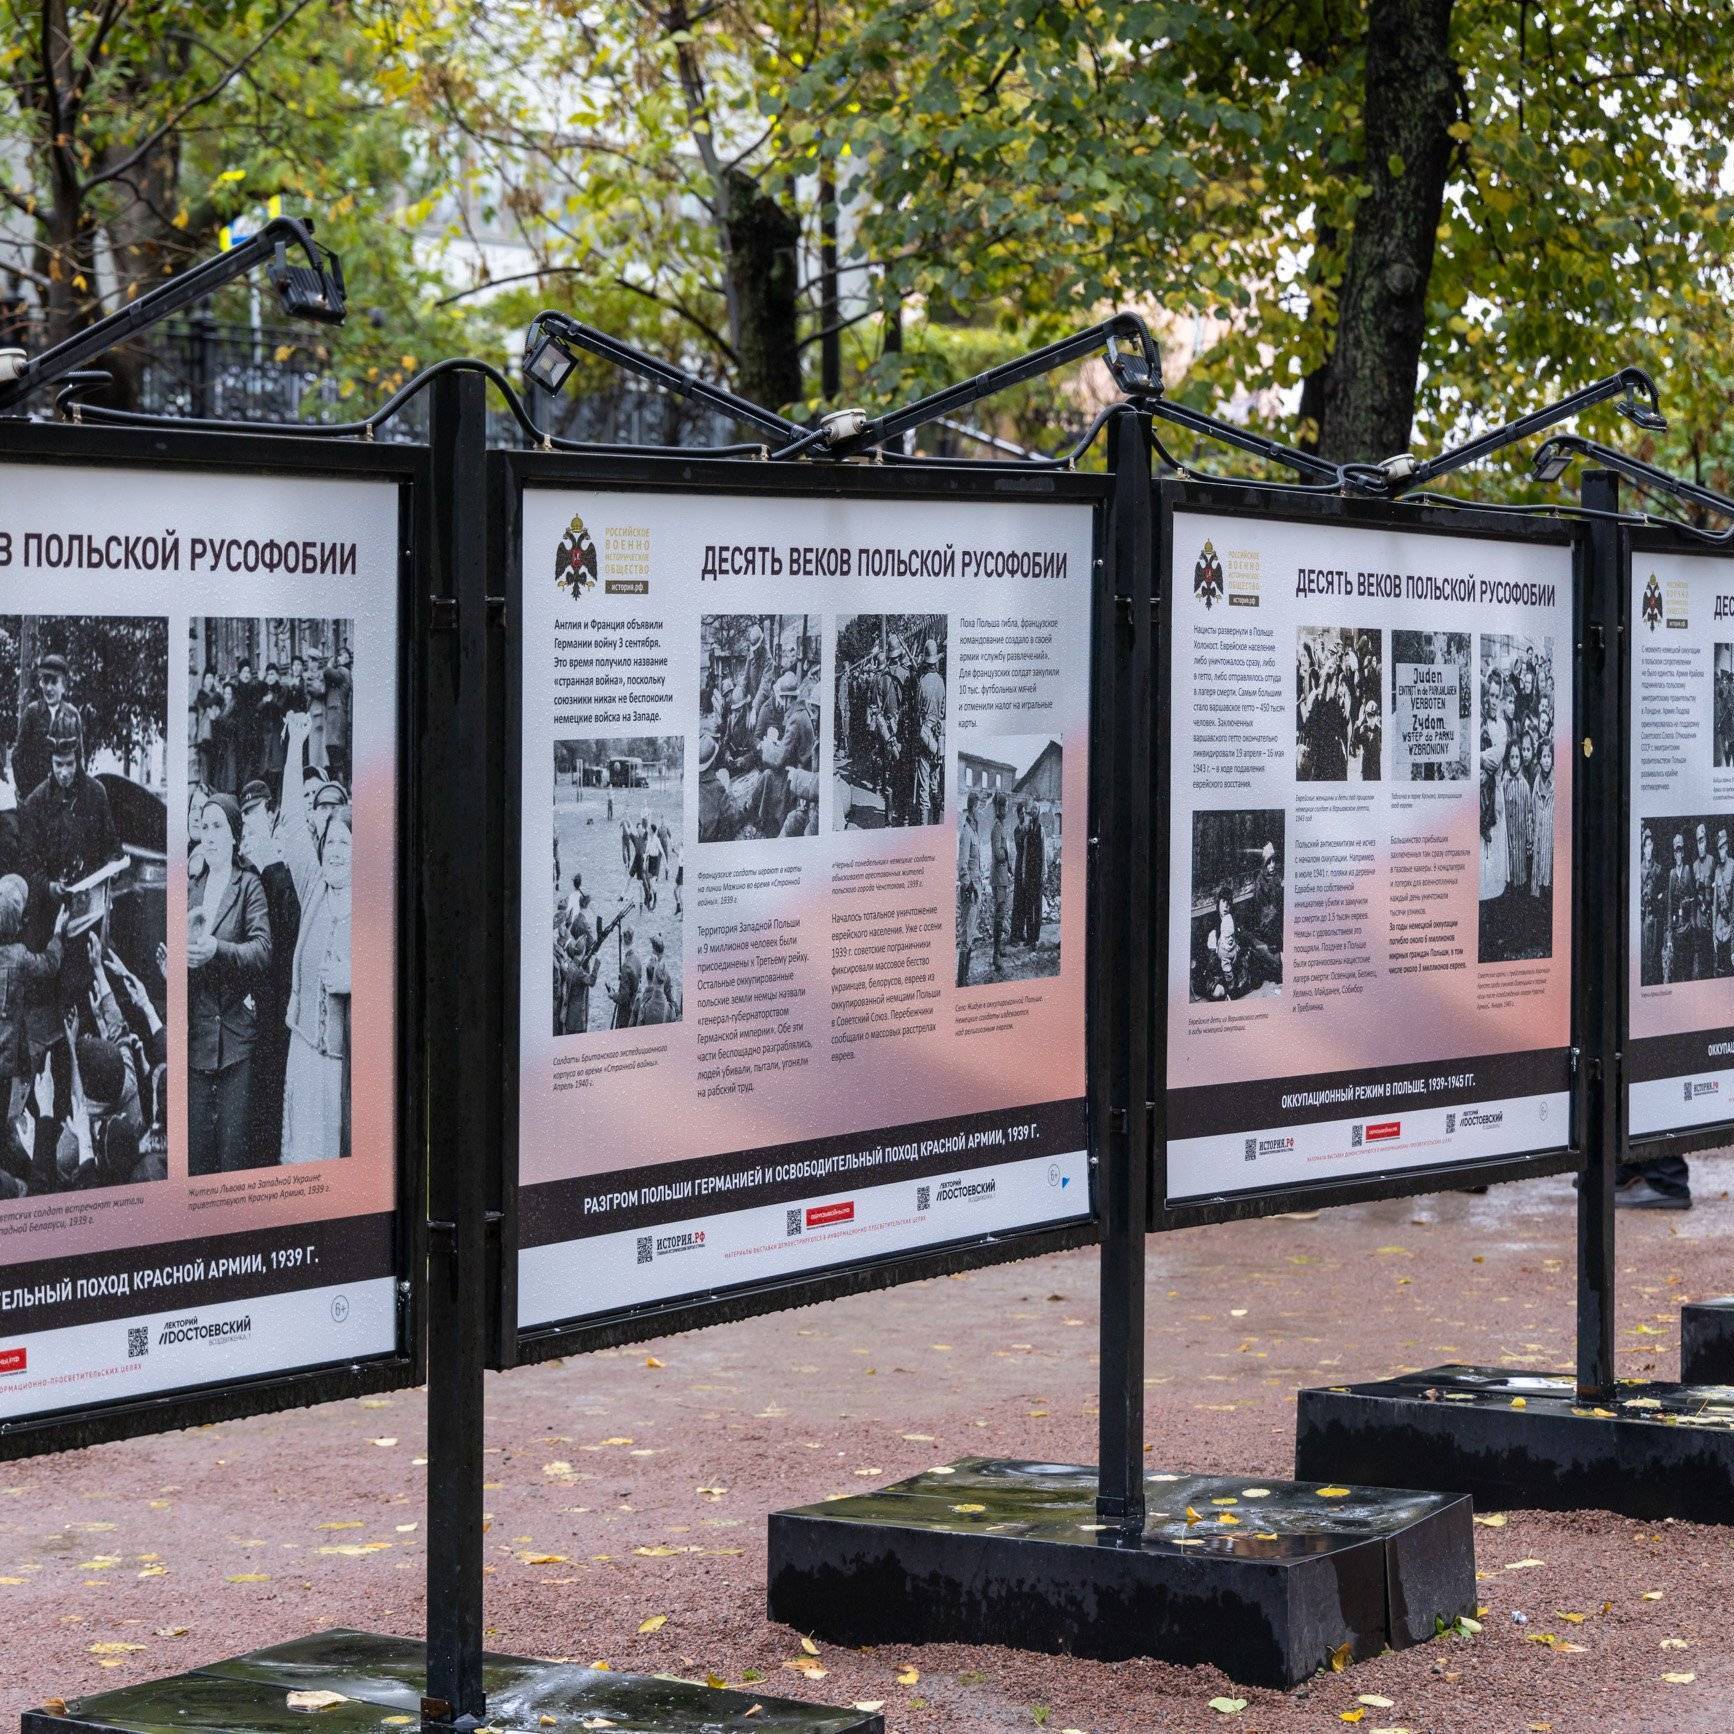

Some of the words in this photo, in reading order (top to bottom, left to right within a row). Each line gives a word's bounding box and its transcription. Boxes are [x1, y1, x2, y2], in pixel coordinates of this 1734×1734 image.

[24, 529, 179, 570] ПОЛЬСКОЙ
[190, 538, 356, 574] РУСОФОБИИ
[605, 564, 649, 574] ОБЩЕСТВО
[701, 545, 782, 581] ДЕСЯТЬ
[789, 547, 851, 576] ВЕКОВ
[858, 548, 955, 577] ПОЛЬСКОЙ
[961, 550, 1067, 578] РУСОФОБИИ
[1296, 568, 1353, 600] ДЕСЯТЬ
[1357, 572, 1401, 598] ВЕКОВ
[1406, 573, 1475, 602] ПОЛЬСКОЙ
[1480, 580, 1555, 606] РУСОФОБИИ
[554, 619, 582, 629] Англия
[583, 621, 588, 629] и
[590, 619, 625, 631] Франция
[626, 618, 663, 629] объявили
[554, 638, 592, 648] Германии
[594, 637, 617, 650] войну
[619, 637, 623, 648] 3
[625, 637, 660, 648] сентября.
[554, 656, 567, 667] Это
[569, 658, 593, 669] время
[595, 658, 631, 668] получило
[633, 658, 668, 666] название
[554, 677, 593, 686] «странная
[595, 674, 625, 686] война»,
[627, 676, 665, 685] поскольку
[553, 696, 592, 705] союзники
[593, 695, 616, 704] никак
[618, 695, 627, 703] не
[628, 692, 673, 703] беспокоили
[553, 715, 592, 724] немецкие
[594, 711, 620, 722] войска
[622, 713, 631, 721] на
[633, 710, 661, 723] Западе.
[831, 912, 862, 923] Началось
[863, 910, 895, 920] тотальное
[896, 906, 937, 917] уничтожение
[698, 923, 738, 938] Территория
[739, 919, 772, 934] Западной
[773, 917, 800, 929] Польши
[831, 927, 868, 941] еврейского
[905, 922, 918, 933] Уже
[923, 922, 942, 932] осени
[697, 946, 702, 954] и
[703, 943, 708, 954] 9
[709, 941, 749, 953] миллионов
[750, 938, 778, 949] человек
[779, 934, 797, 946] были
[832, 946, 847, 958] 1939
[853, 945, 885, 956] советские
[886, 940, 931, 952] пограничники
[697, 959, 749, 974] присоединены
[756, 953, 787, 968] Третьему
[788, 950, 808, 965] рейху.
[831, 963, 874, 977] фиксировали
[875, 960, 905, 970] массовое
[906, 955, 929, 967] бегство
[697, 976, 735, 990] Остальные
[736, 972, 794, 987] оккупированные
[904, 974, 927, 986] евреев
[927, 973, 935, 982] из
[697, 997, 730, 1008] польские
[731, 994, 752, 1004] земли
[753, 991, 777, 1002] немцы
[778, 988, 806, 999] назвали
[830, 994, 884, 1011] оккупированной
[885, 992, 915, 1003] немцами
[916, 987, 941, 1000] Польши
[836, 1012, 869, 1026] Советский
[890, 1005, 933, 1021] Перебежчики
[697, 1029, 738, 1045] Германской
[777, 1021, 791, 1034] Обе
[792, 1023, 803, 1032] эти
[831, 1030, 864, 1045] сообщали
[870, 1028, 901, 1039] массовых
[902, 1023, 936, 1037] расстрелах
[697, 1052, 716, 1062] части
[717, 1044, 761, 1061] беспощадно
[697, 1066, 721, 1082] людей
[753, 1061, 780, 1073] пытали,
[781, 1057, 808, 1070] угоняли
[697, 1089, 706, 1098] на
[707, 1082, 736, 1097] рабский
[1281, 1087, 1353, 1108] ОККУПАЦИОННЫЙ
[1355, 1084, 1384, 1099] РЕЖИМ
[1385, 1083, 1391, 1096] В
[1392, 1079, 1426, 1095] ПОЛЬШЕ,
[1429, 1074, 1464, 1090] 1939-1945
[1465, 1073, 1475, 1086] ГГ.
[1259, 1137, 1294, 1152] ИСТОРИЯ.РФ
[584, 1189, 638, 1214] РАЗГРОМ
[641, 1180, 691, 1204] ПОЛЬШИ
[695, 1167, 762, 1195] ГЕРМАНИЕЙ
[765, 1167, 772, 1183] И
[775, 1149, 882, 1182] ОСВОБОДИТЕЛЬНЫЙ
[885, 1142, 918, 1165] ПОХОД
[920, 1133, 965, 1156] КРАСНОЙ
[968, 1128, 1005, 1150] АРМИИ,
[1008, 1124, 1029, 1142] 1939
[1031, 1123, 1039, 1138] Г.
[657, 1231, 705, 1250] ИСТОРИЯ.РФ
[77, 1273, 129, 1301] ПОХОД
[134, 1260, 204, 1290] КРАСНОЙ
[208, 1253, 266, 1280] АРМИИ,
[271, 1247, 302, 1269] 1939
[306, 1245, 318, 1264] Г.
[163, 1317, 198, 1330] ЛЕКТОРИЙ
